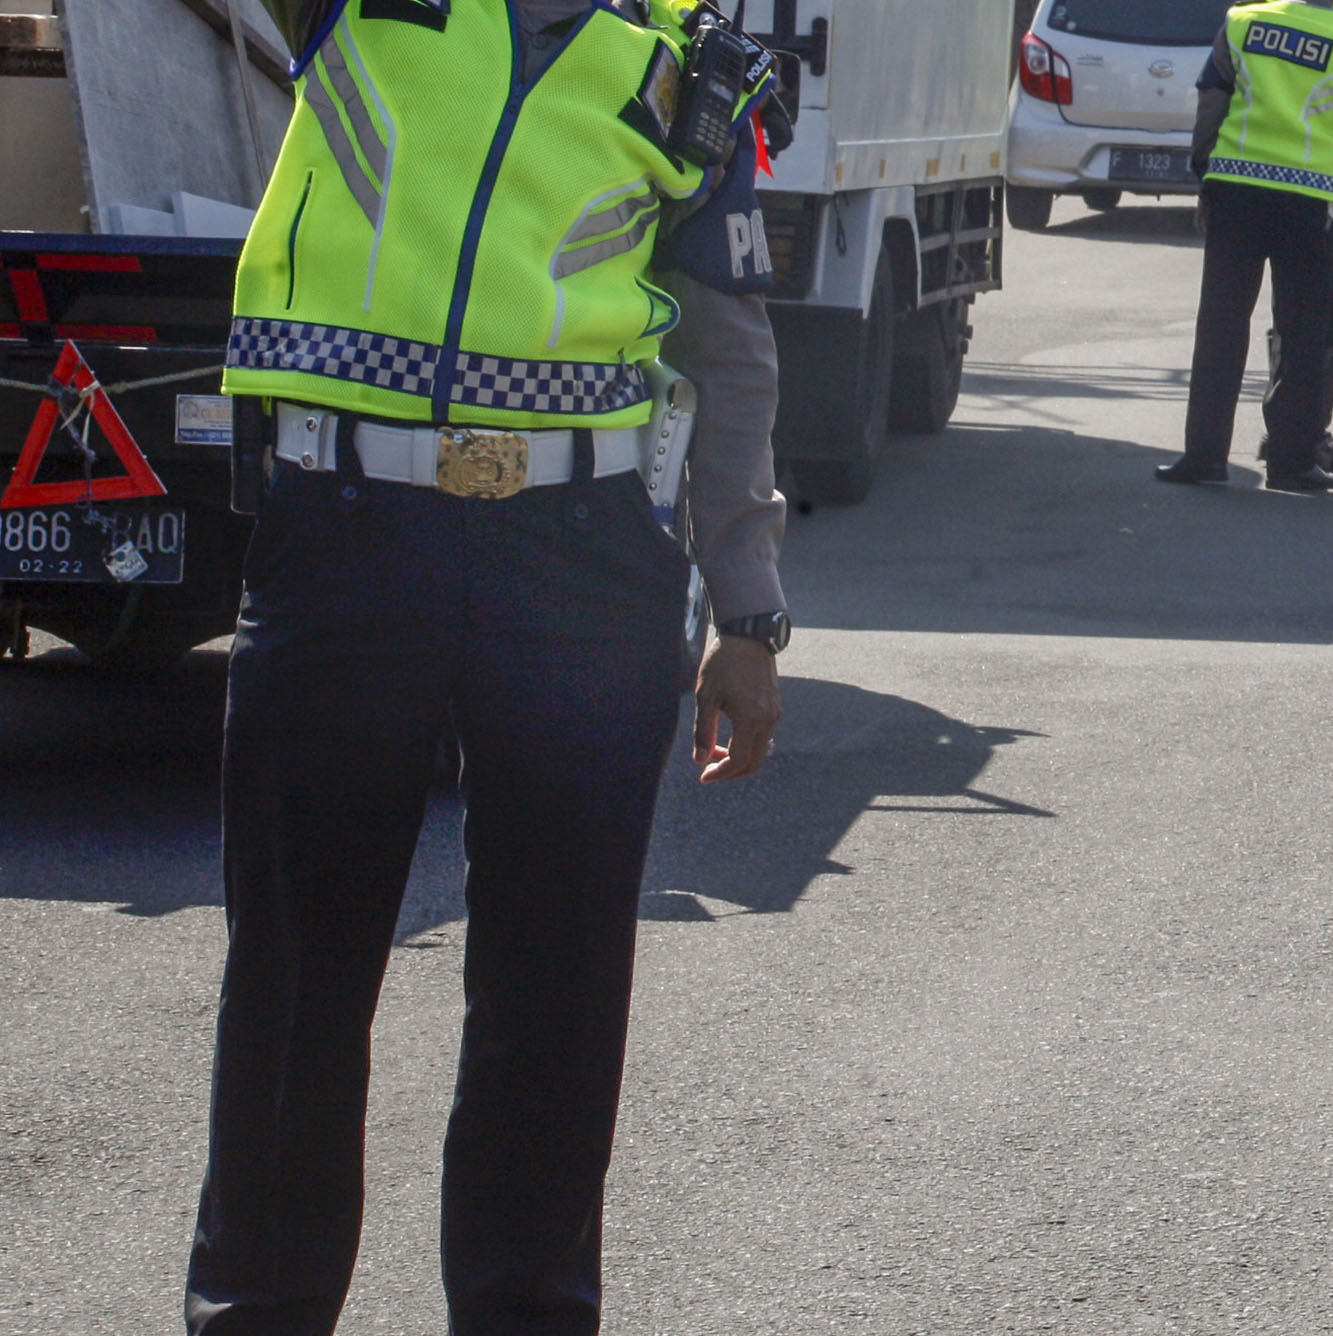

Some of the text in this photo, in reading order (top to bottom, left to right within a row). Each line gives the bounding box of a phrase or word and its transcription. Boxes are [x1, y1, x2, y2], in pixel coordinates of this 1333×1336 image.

[1245, 22, 1332, 67] POLISI
[0, 510, 71, 553] 866
[19, 558, 83, 574] 02-22
